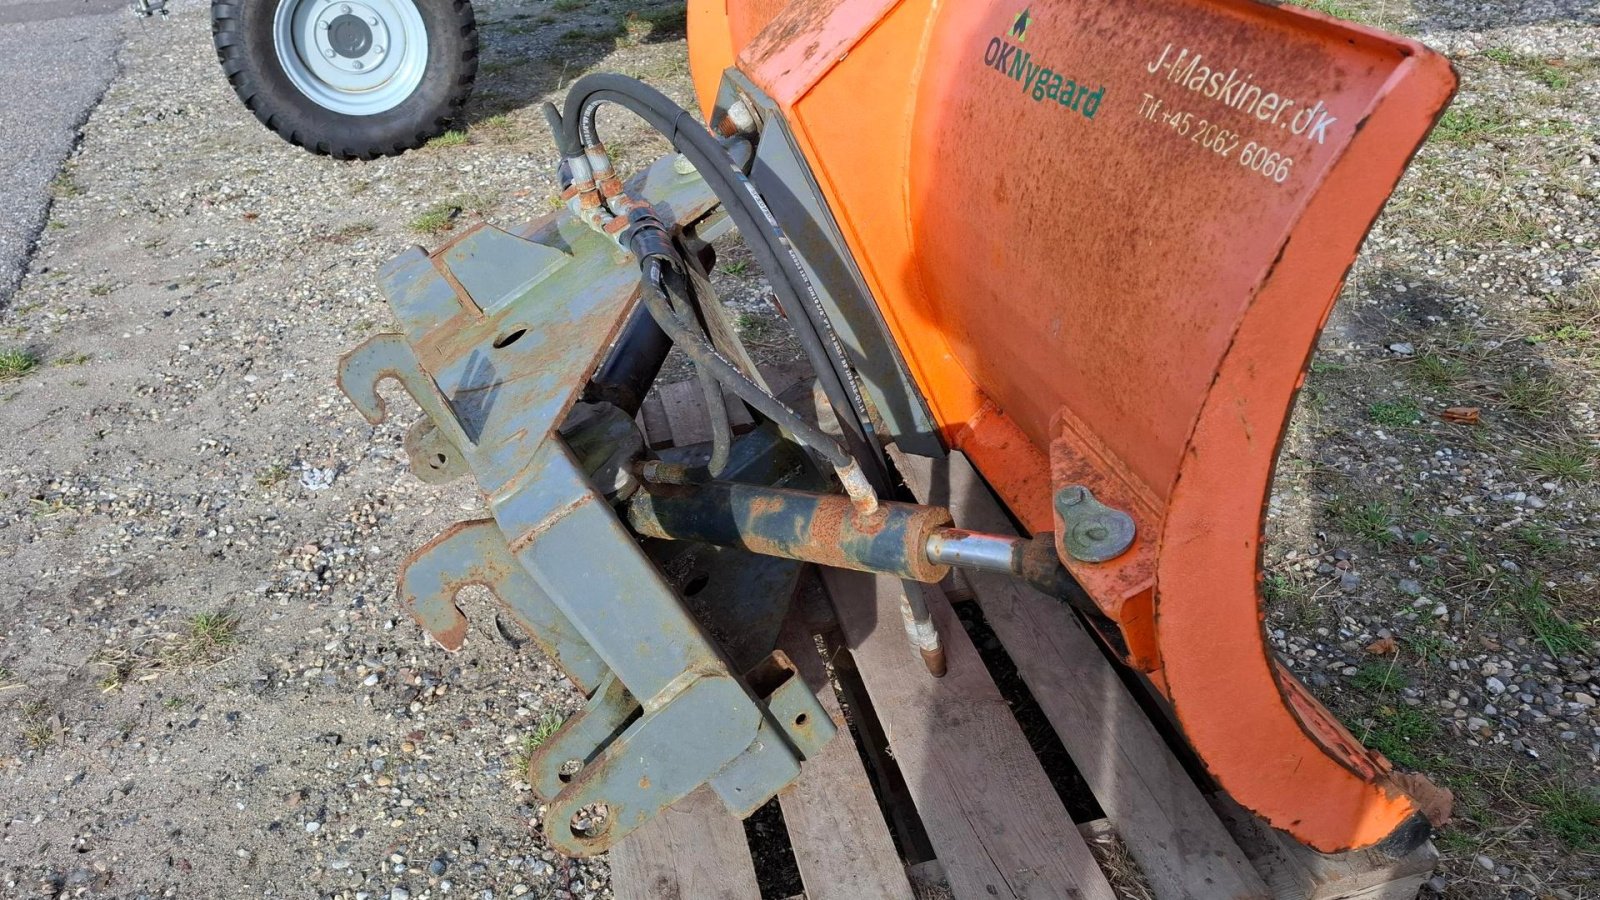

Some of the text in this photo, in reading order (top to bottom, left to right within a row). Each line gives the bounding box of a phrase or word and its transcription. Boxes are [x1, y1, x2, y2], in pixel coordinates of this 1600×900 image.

[984, 36, 1106, 121] OKNygaard
[1147, 43, 1337, 145] J-Maskiner.dk
[1239, 141, 1293, 183] 6066
